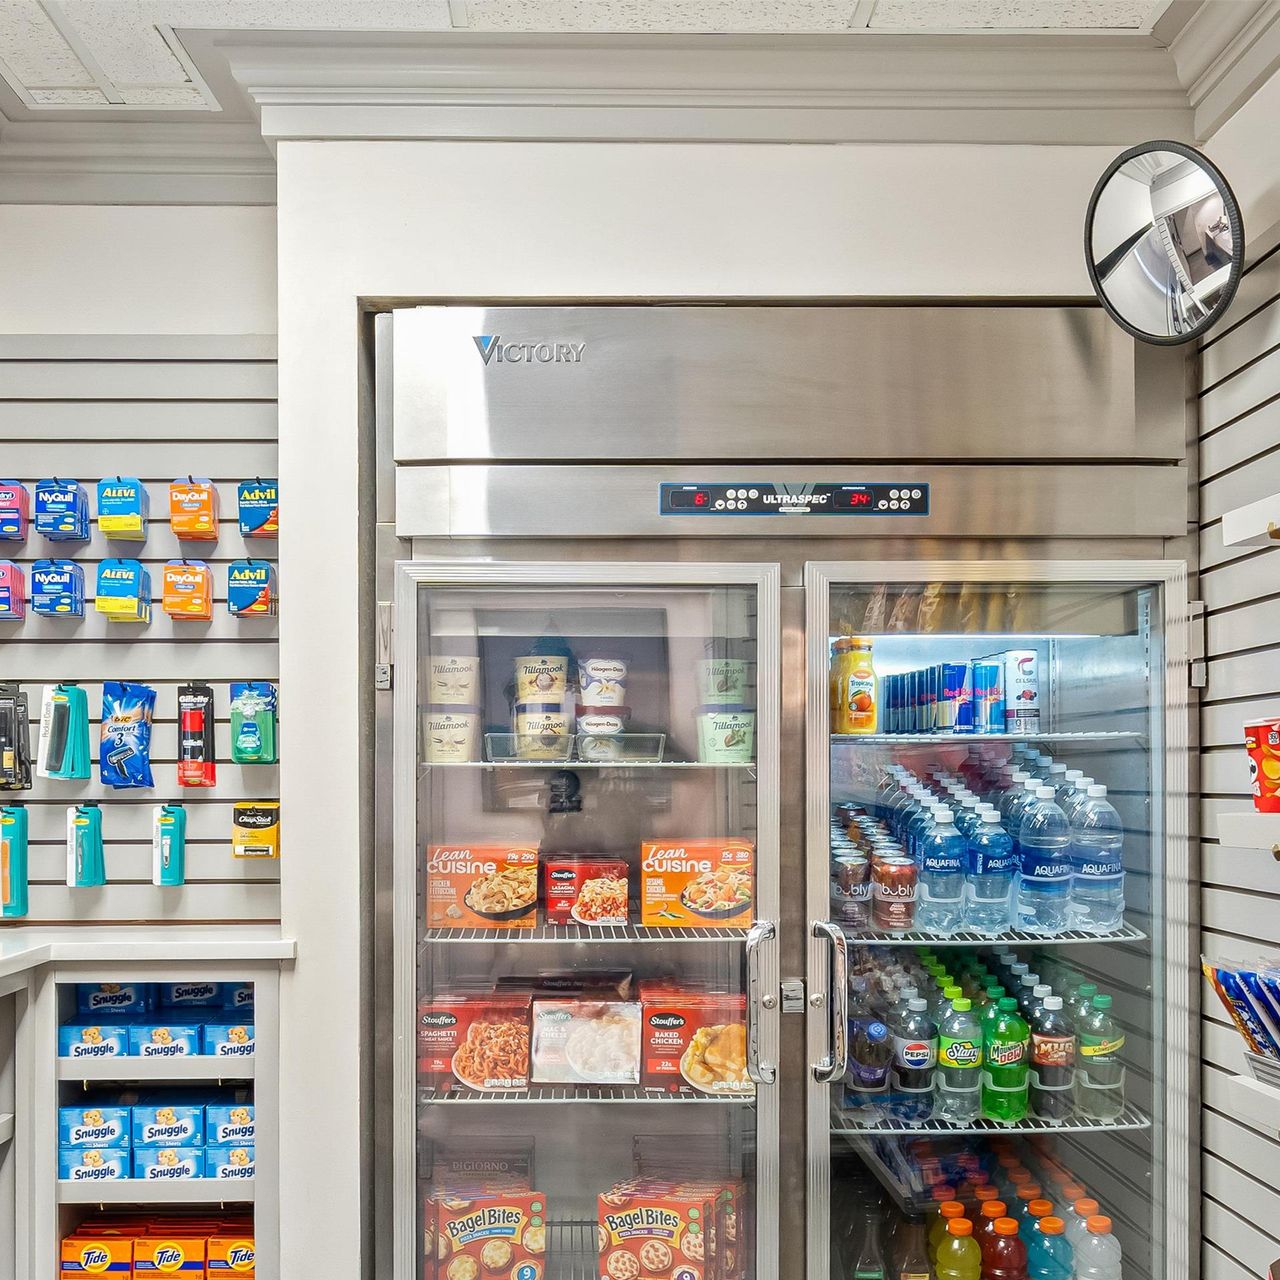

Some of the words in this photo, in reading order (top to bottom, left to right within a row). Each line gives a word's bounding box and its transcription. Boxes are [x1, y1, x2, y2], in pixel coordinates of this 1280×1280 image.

[472, 335, 586, 366] VICTORY
[39, 492, 74, 503] NyQuil
[102, 488, 136, 498] ALEVE
[172, 491, 208, 501] DayQuil
[240, 489, 276, 499] Advil
[763, 493, 827, 504] ULTRASPEC
[35, 573, 70, 584] NyQuil
[101, 570, 135, 580] ALEVE
[167, 573, 202, 584] DayQuil
[231, 569, 266, 580] Advil
[523, 663, 564, 675] Tillamook
[108, 725, 135, 733] Comfort
[428, 719, 470, 731] Tillamook
[527, 719, 567, 731] Tillamook
[115, 733, 124, 746] 3
[432, 847, 473, 862] Lean
[648, 845, 688, 862] Lean
[925, 857, 960, 868] AQUAFINA
[882, 883, 916, 896] bubly
[93, 993, 132, 1006] Snuggle
[422, 1015, 456, 1024] Stouffer's
[650, 1016, 684, 1026] Stouffer's
[651, 1037, 683, 1045] CHICKEN
[904, 1050, 929, 1058] PEPSI
[75, 1126, 115, 1141] Snuggle
[147, 1125, 188, 1139] Snuggle
[150, 1165, 190, 1179] Snuggle
[447, 1209, 486, 1237] Bagel
[488, 1208, 521, 1225] Bites
[606, 1209, 644, 1231] Bagel
[645, 1209, 679, 1229] Bites
[83, 1251, 108, 1266] Tide
[157, 1250, 181, 1266] Tide
[523, 1268, 530, 1280] 9
